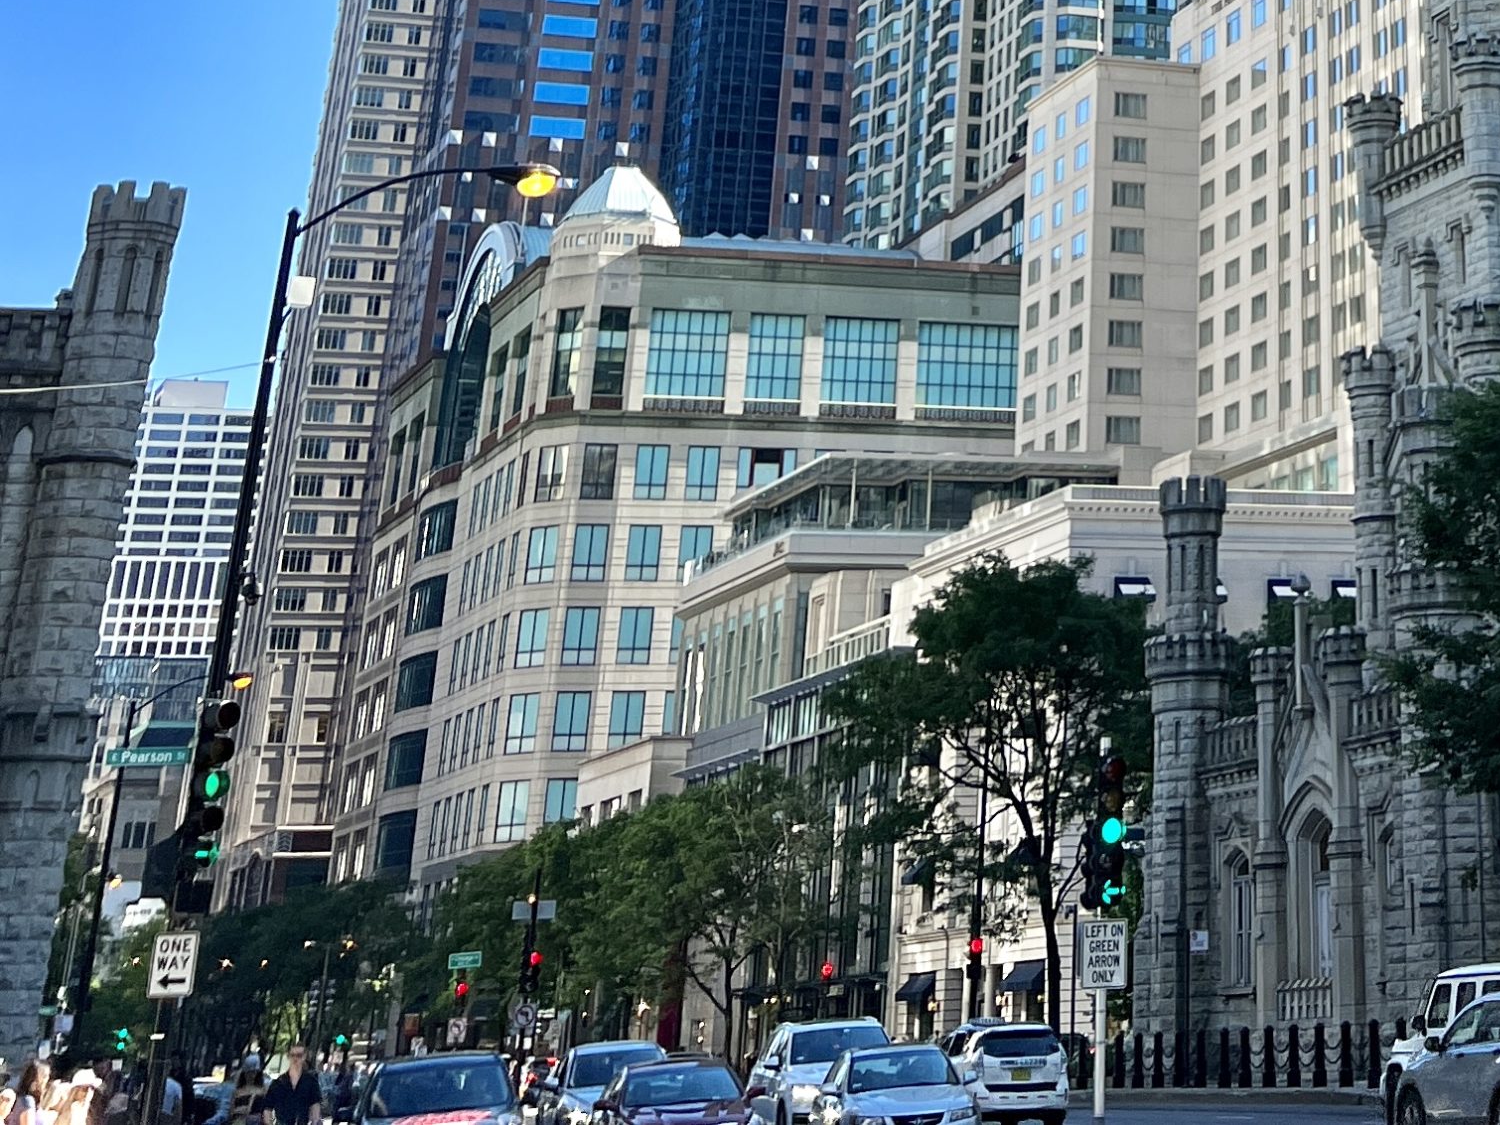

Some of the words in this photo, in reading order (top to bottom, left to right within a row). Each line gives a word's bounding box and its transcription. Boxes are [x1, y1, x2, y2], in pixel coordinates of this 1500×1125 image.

[121, 750, 172, 763] Pearson
[1085, 924, 1108, 938] LEFT
[1111, 924, 1123, 936] ON
[160, 937, 192, 954] ONE
[1089, 939, 1119, 953] GREEN
[157, 955, 190, 971] WAY
[1087, 954, 1120, 968] ARROW
[1091, 969, 1115, 983] ONLY
